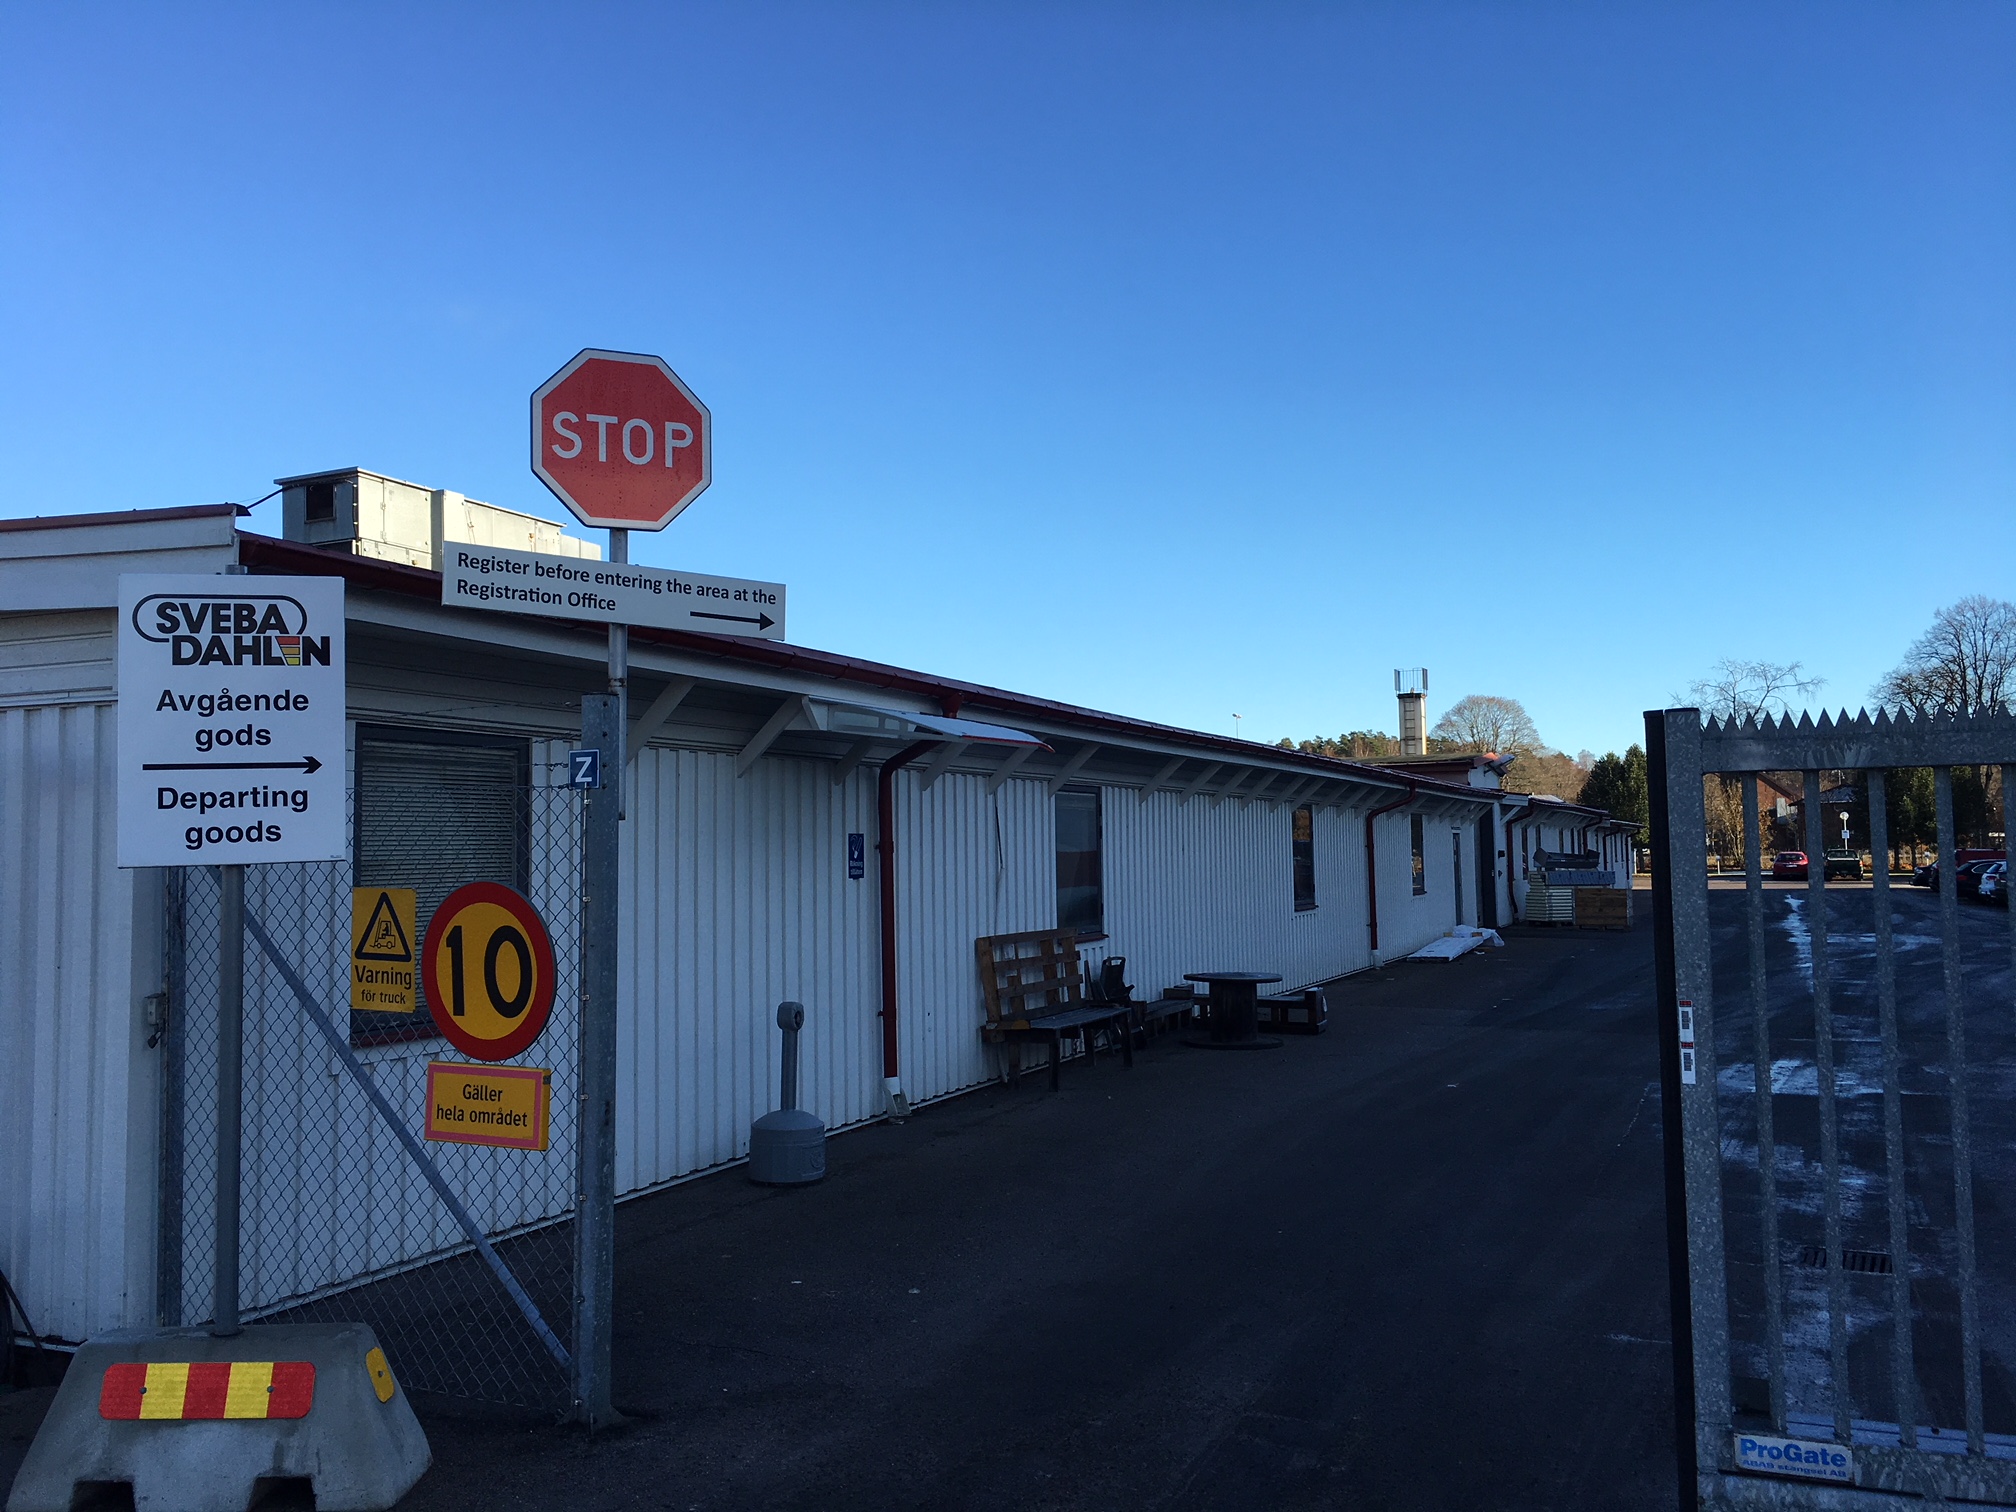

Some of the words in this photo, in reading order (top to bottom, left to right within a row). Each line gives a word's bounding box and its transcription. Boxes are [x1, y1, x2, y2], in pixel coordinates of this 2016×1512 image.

[551, 411, 694, 468] STOP
[457, 551, 530, 574] Register
[534, 564, 590, 583] before
[594, 573, 662, 594] entering
[666, 579, 692, 596] the
[696, 586, 729, 600] area
[733, 586, 749, 602] at
[752, 588, 777, 606] the
[456, 578, 563, 604] Registration
[567, 591, 616, 611] Office
[156, 601, 289, 635] SVEBA
[156, 687, 309, 717] Avgående
[195, 724, 272, 752] gods
[575, 756, 592, 783] Z
[157, 785, 309, 815] Departing
[185, 820, 282, 850] goods
[355, 964, 412, 990] Varning
[445, 924, 533, 1019] 10
[361, 990, 376, 1003] för
[379, 992, 406, 1005] truck
[462, 1083, 503, 1103] Gäller
[436, 1104, 465, 1123] hela
[469, 1107, 528, 1128] området
[1740, 1438, 1847, 1468] ProGate
